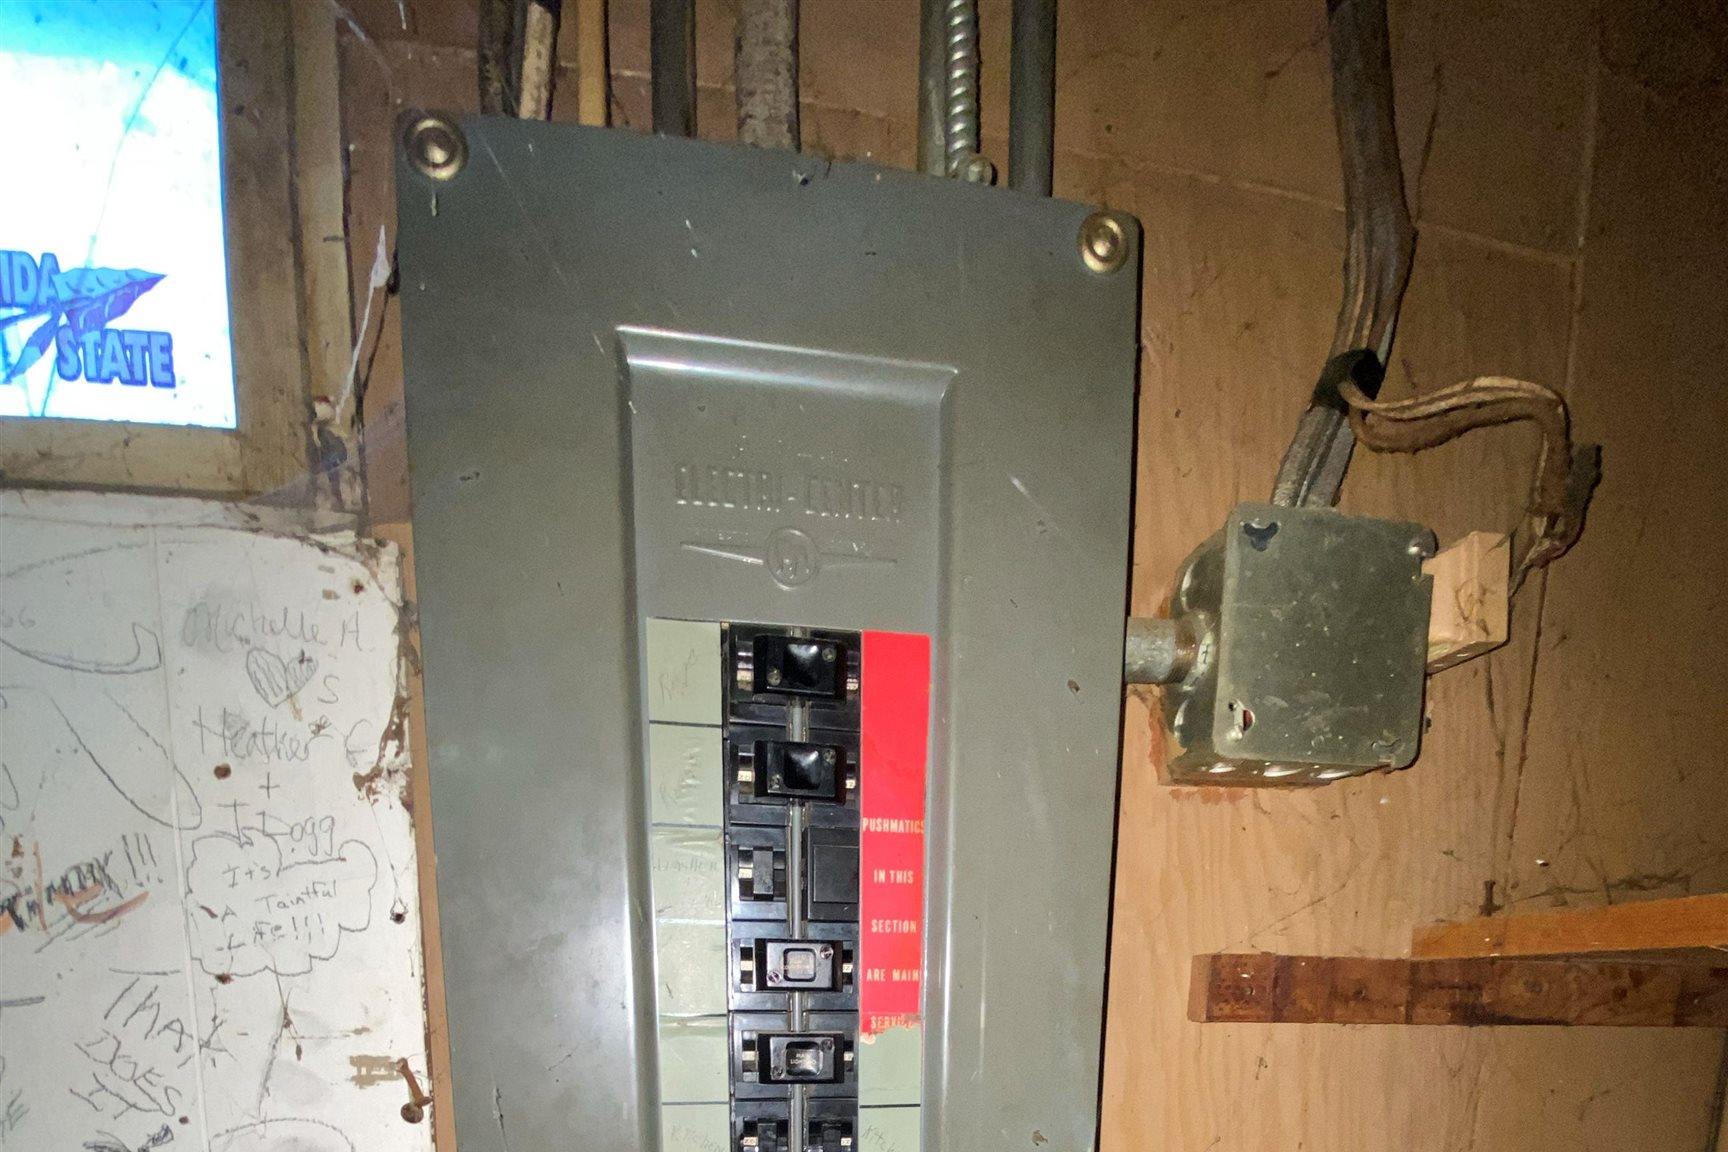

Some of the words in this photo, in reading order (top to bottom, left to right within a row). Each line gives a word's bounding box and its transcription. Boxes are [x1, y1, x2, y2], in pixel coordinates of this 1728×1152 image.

[56, 325, 176, 388] STATE
[862, 817, 925, 834] PUSHMATICS
[873, 869, 886, 884] IN
[889, 869, 915, 885] THIS
[871, 919, 918, 934] SECTION
[866, 968, 887, 983] ARE
[892, 968, 920, 983] MAIN
